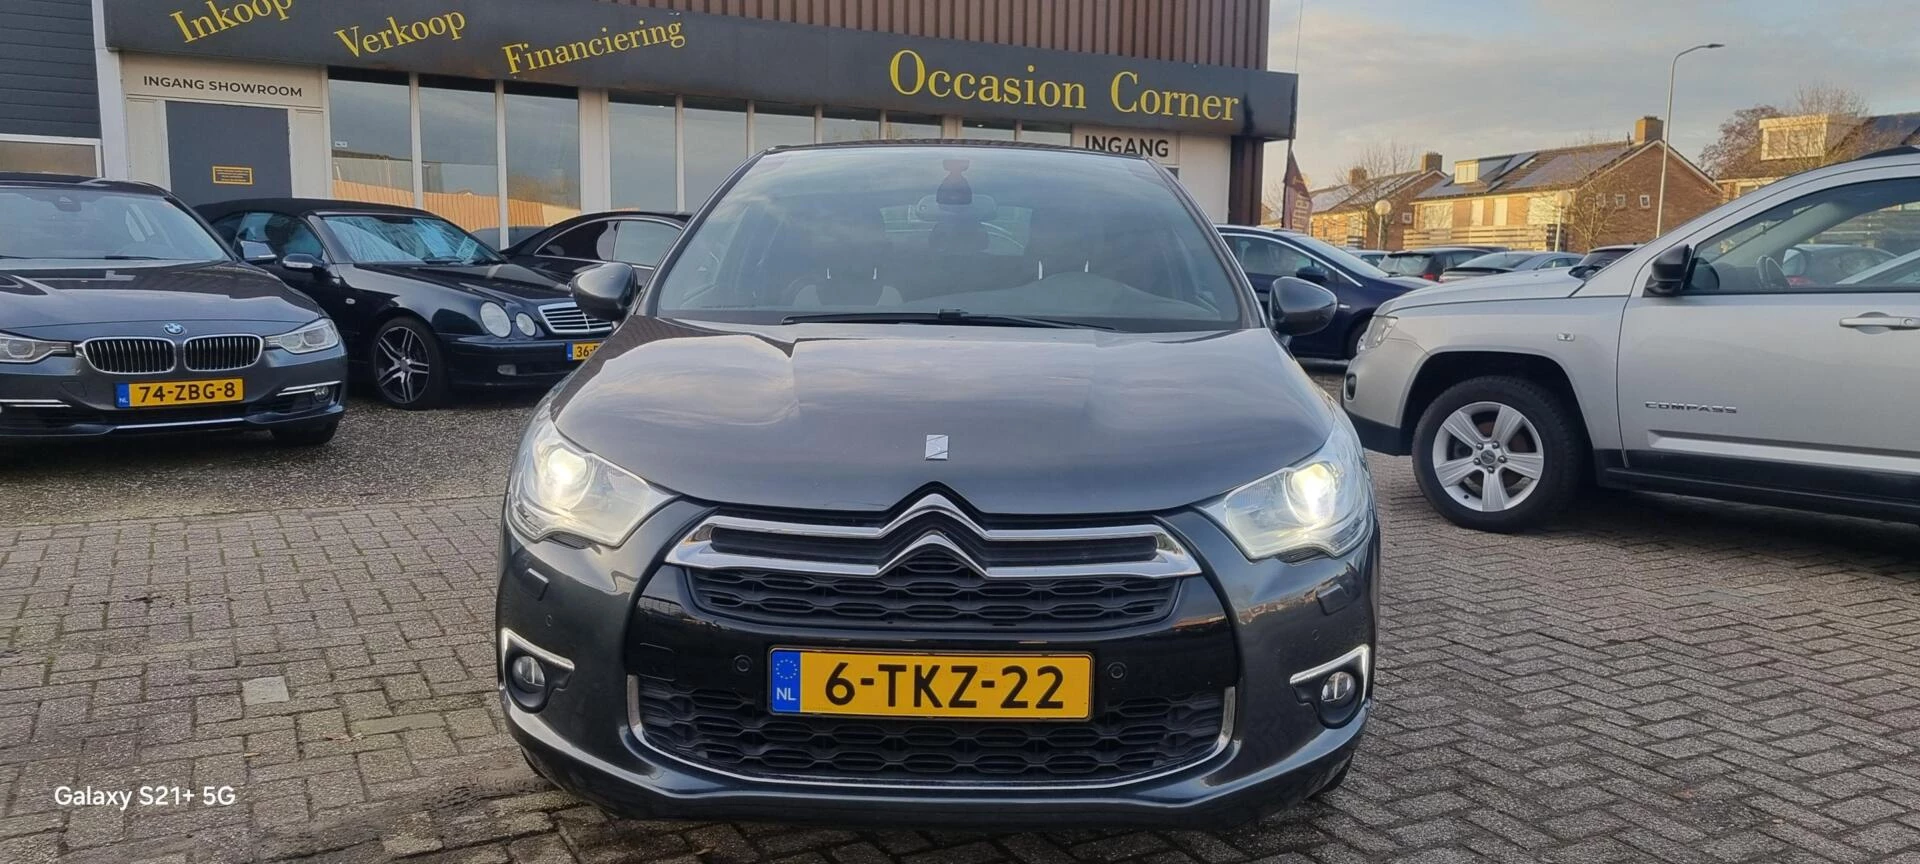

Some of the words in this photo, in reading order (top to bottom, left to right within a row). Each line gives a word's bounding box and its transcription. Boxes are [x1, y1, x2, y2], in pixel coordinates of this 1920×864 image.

[169, 0, 292, 43] Inkoop
[333, 11, 465, 57] Verkoop
[502, 20, 686, 74] Financiering
[143, 76, 205, 90] INGANG
[208, 80, 303, 97] SHOWROOM
[889, 50, 1087, 108] Occasion
[1110, 71, 1239, 121] Corner
[1085, 135, 1169, 157] INGANG
[138, 382, 236, 403] 74-ZBG-8
[1645, 401, 1737, 413] COMPASS
[776, 687, 796, 701] NL
[825, 661, 1064, 709] 6-TKZ-22
